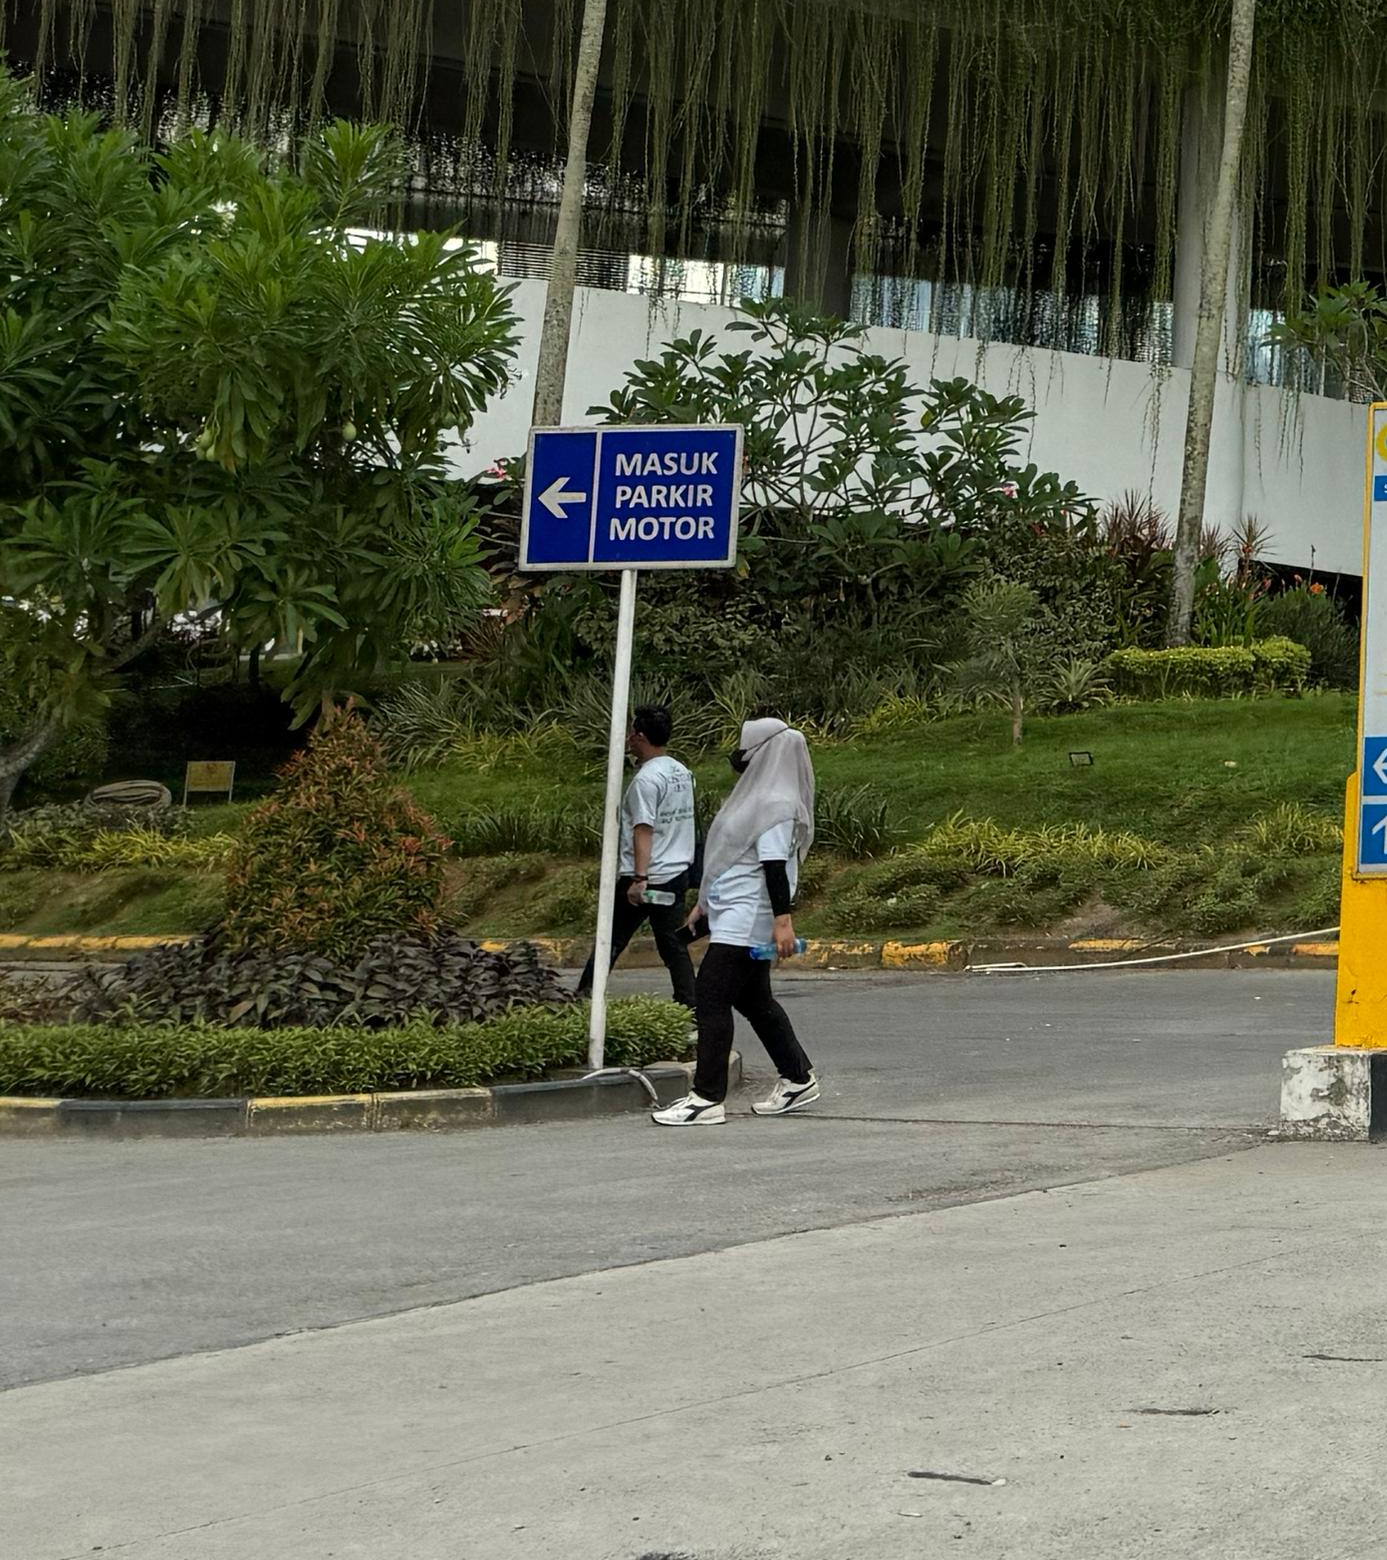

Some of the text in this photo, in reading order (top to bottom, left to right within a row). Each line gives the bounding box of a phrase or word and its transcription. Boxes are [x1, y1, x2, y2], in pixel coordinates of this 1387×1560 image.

[615, 452, 719, 476] MASUK
[615, 484, 714, 509] PARKIR
[609, 516, 715, 541] MOTOR
